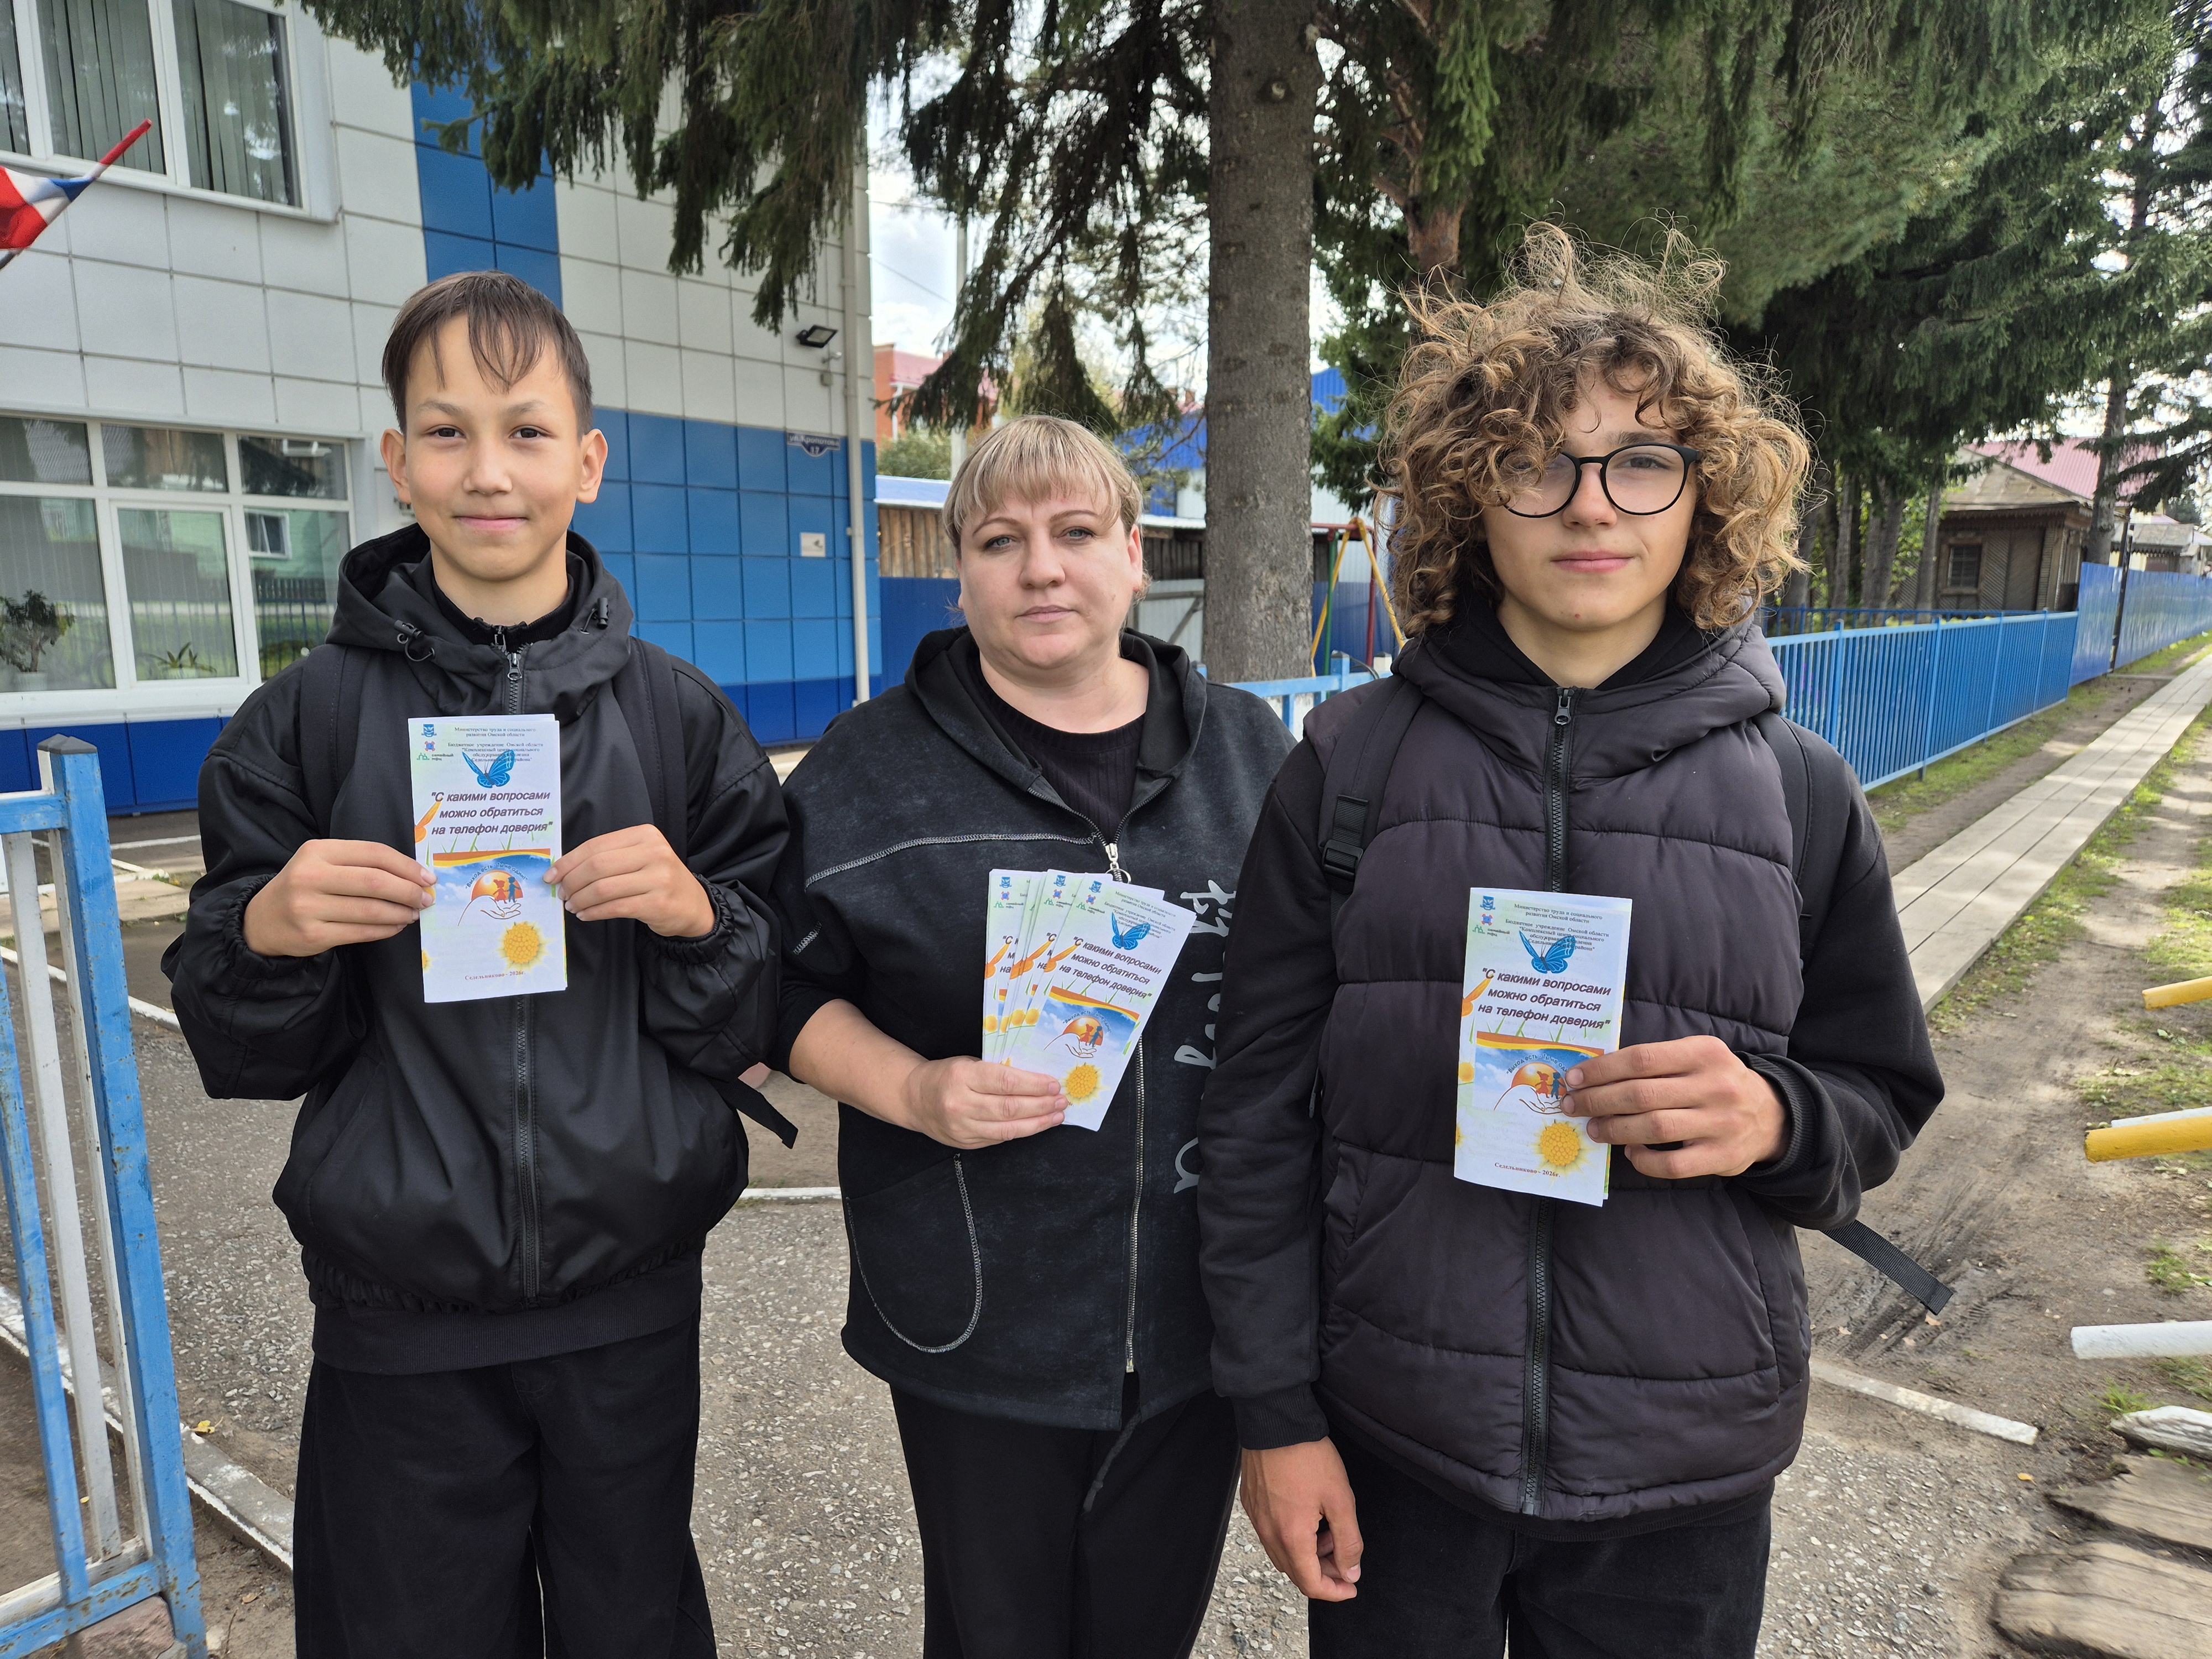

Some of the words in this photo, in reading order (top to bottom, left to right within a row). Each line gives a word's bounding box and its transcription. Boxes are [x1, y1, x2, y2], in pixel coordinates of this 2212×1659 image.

[431, 791, 444, 802] "С
[447, 793, 487, 802] какими
[489, 792, 551, 802] вопросами
[439, 810, 477, 818] можно
[479, 807, 544, 818] обратиться
[431, 827, 446, 835] на
[449, 823, 498, 836] телефон
[500, 821, 553, 833] доверия"
[1514, 904, 1550, 912] Министерство
[1505, 919, 1533, 927] Бюджетное
[1519, 926, 1556, 935] "Комплексный
[1003, 935, 1013, 945] "С
[1046, 932, 1057, 942] "С
[1073, 936, 1083, 946] "С
[1082, 942, 1114, 957] какими
[1114, 953, 1162, 975] вопросами
[1071, 953, 1100, 968] можно
[1100, 963, 1150, 985] обратиться
[1058, 964, 1072, 973] на
[1072, 968, 1111, 986] телефон
[1109, 982, 1152, 999] доверия"
[1482, 967, 1495, 979] "С
[1497, 973, 1541, 986] какими
[1542, 979, 1611, 996] вопросами
[1488, 988, 1527, 1001] можно
[1530, 994, 1601, 1012] обратиться
[1478, 1004, 1493, 1014] на
[1496, 1006, 1549, 1021] телефон
[1550, 1014, 1611, 1029] доверия"
[1495, 1162, 1537, 1174] Седельниково
